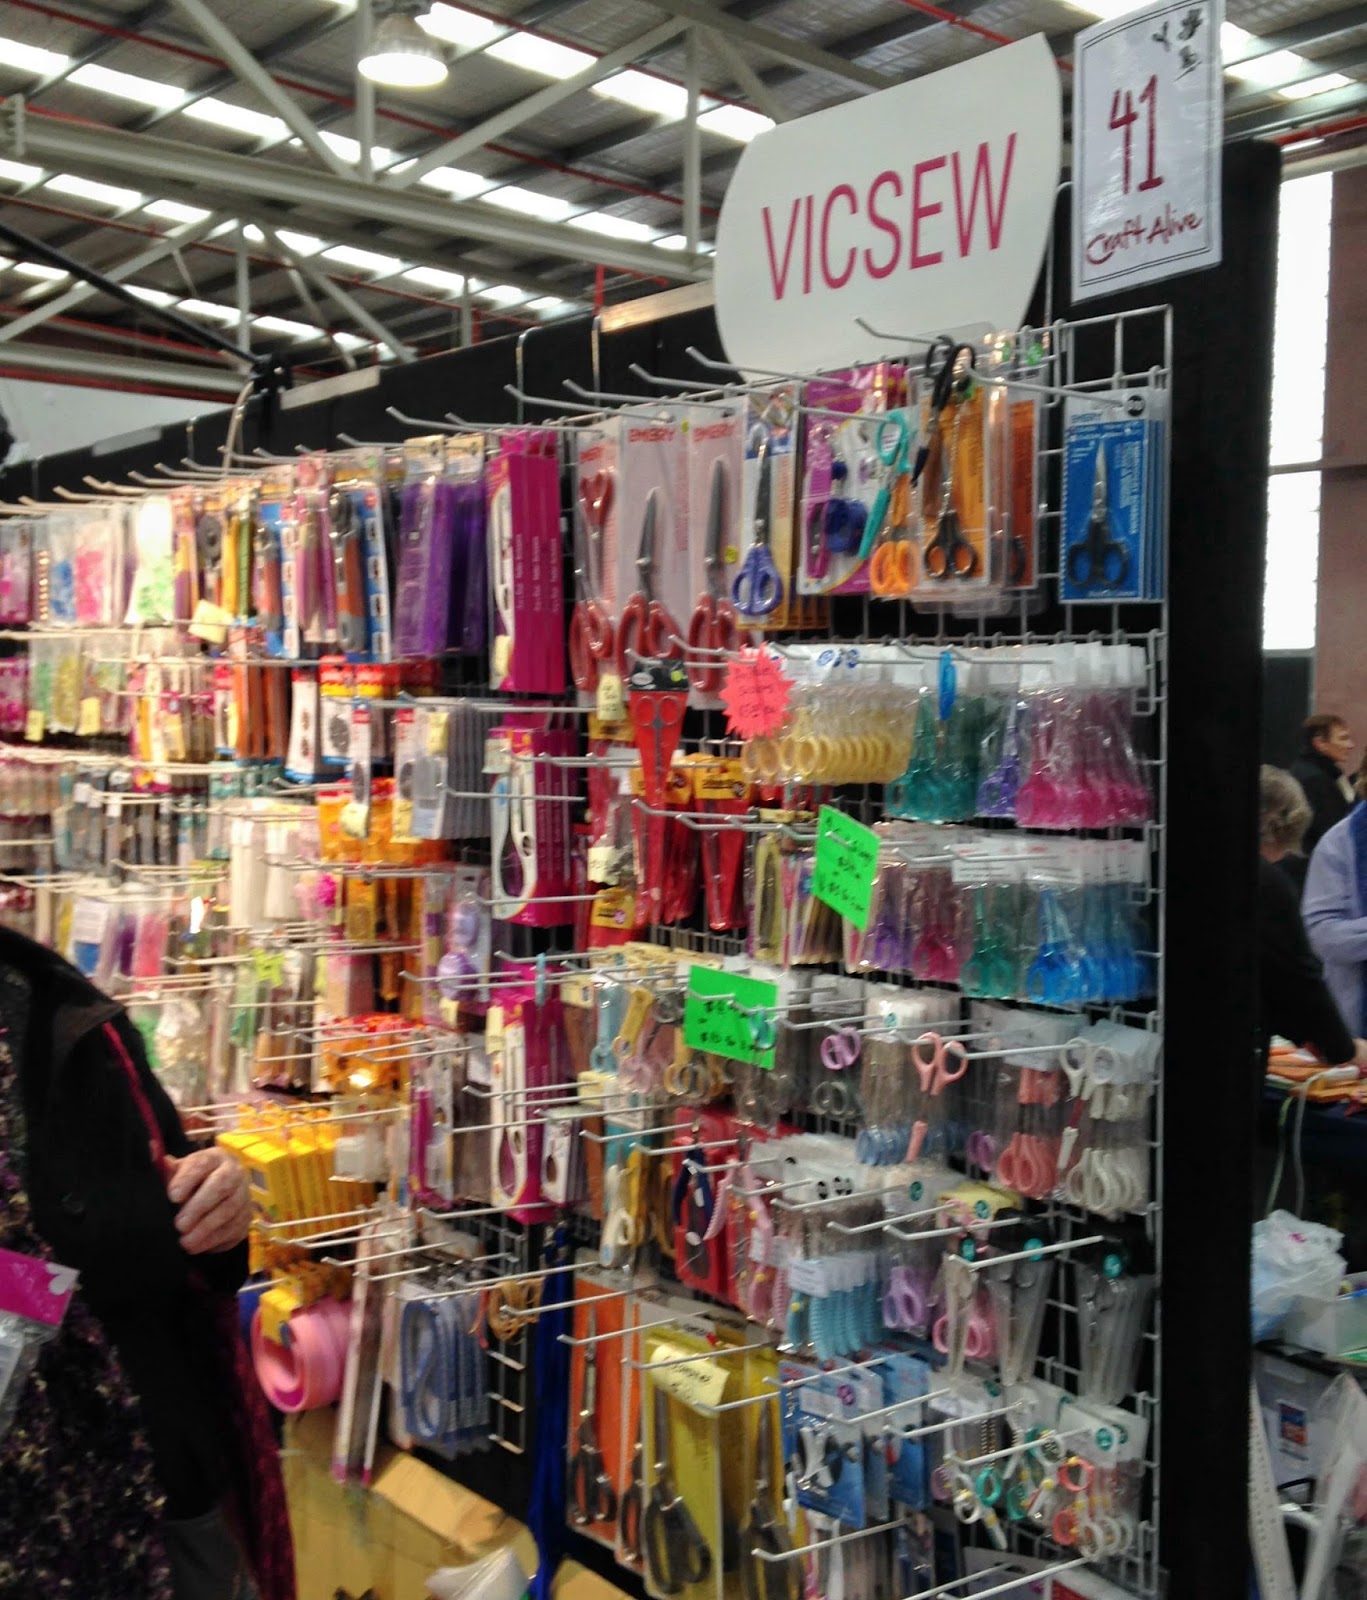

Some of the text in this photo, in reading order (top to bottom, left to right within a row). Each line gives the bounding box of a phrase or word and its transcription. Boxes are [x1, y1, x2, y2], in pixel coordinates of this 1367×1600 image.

[1109, 73, 1164, 195] 41
[762, 132, 1018, 301] VICSEW
[1086, 202, 1203, 265] Craft Alive
